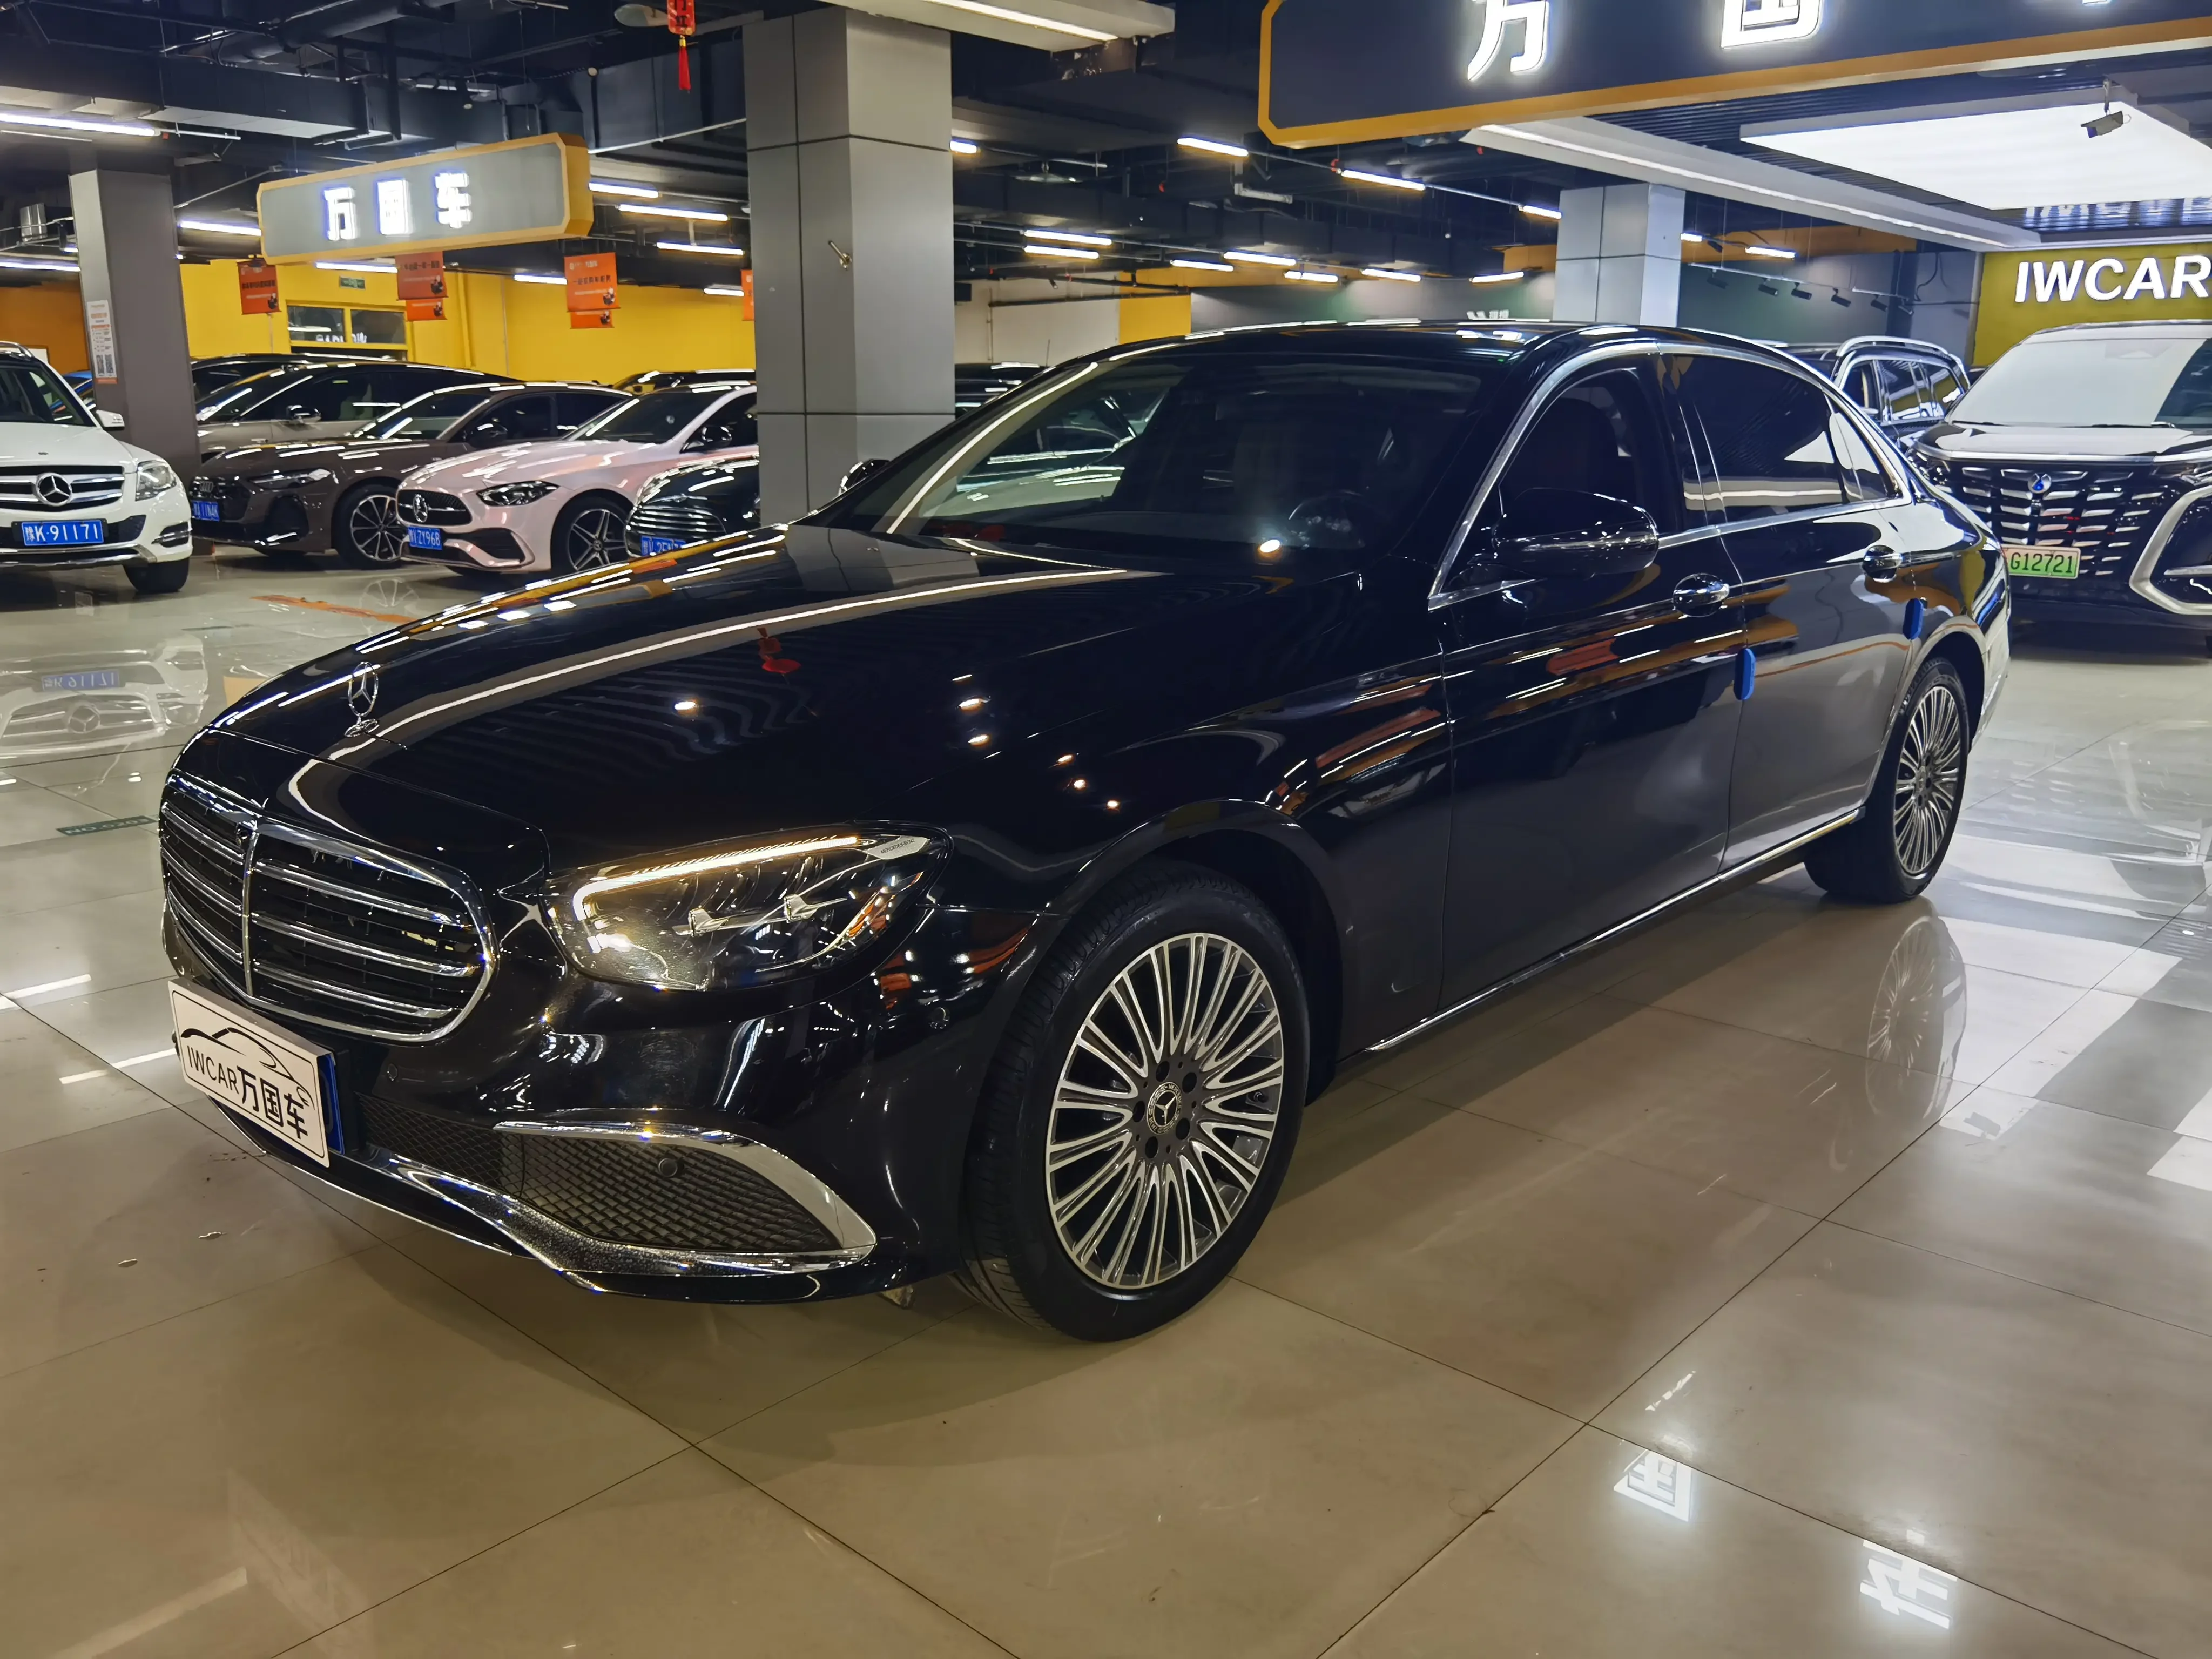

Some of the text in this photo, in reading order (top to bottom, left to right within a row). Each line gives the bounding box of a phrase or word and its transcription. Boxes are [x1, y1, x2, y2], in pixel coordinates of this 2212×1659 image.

[2015, 255, 2212, 303] IWCAR
[2010, 552, 2073, 574] G12721
[880, 838, 915, 854] MERCEDES-BENZ
[187, 1045, 308, 1139] IWCAR万国车
